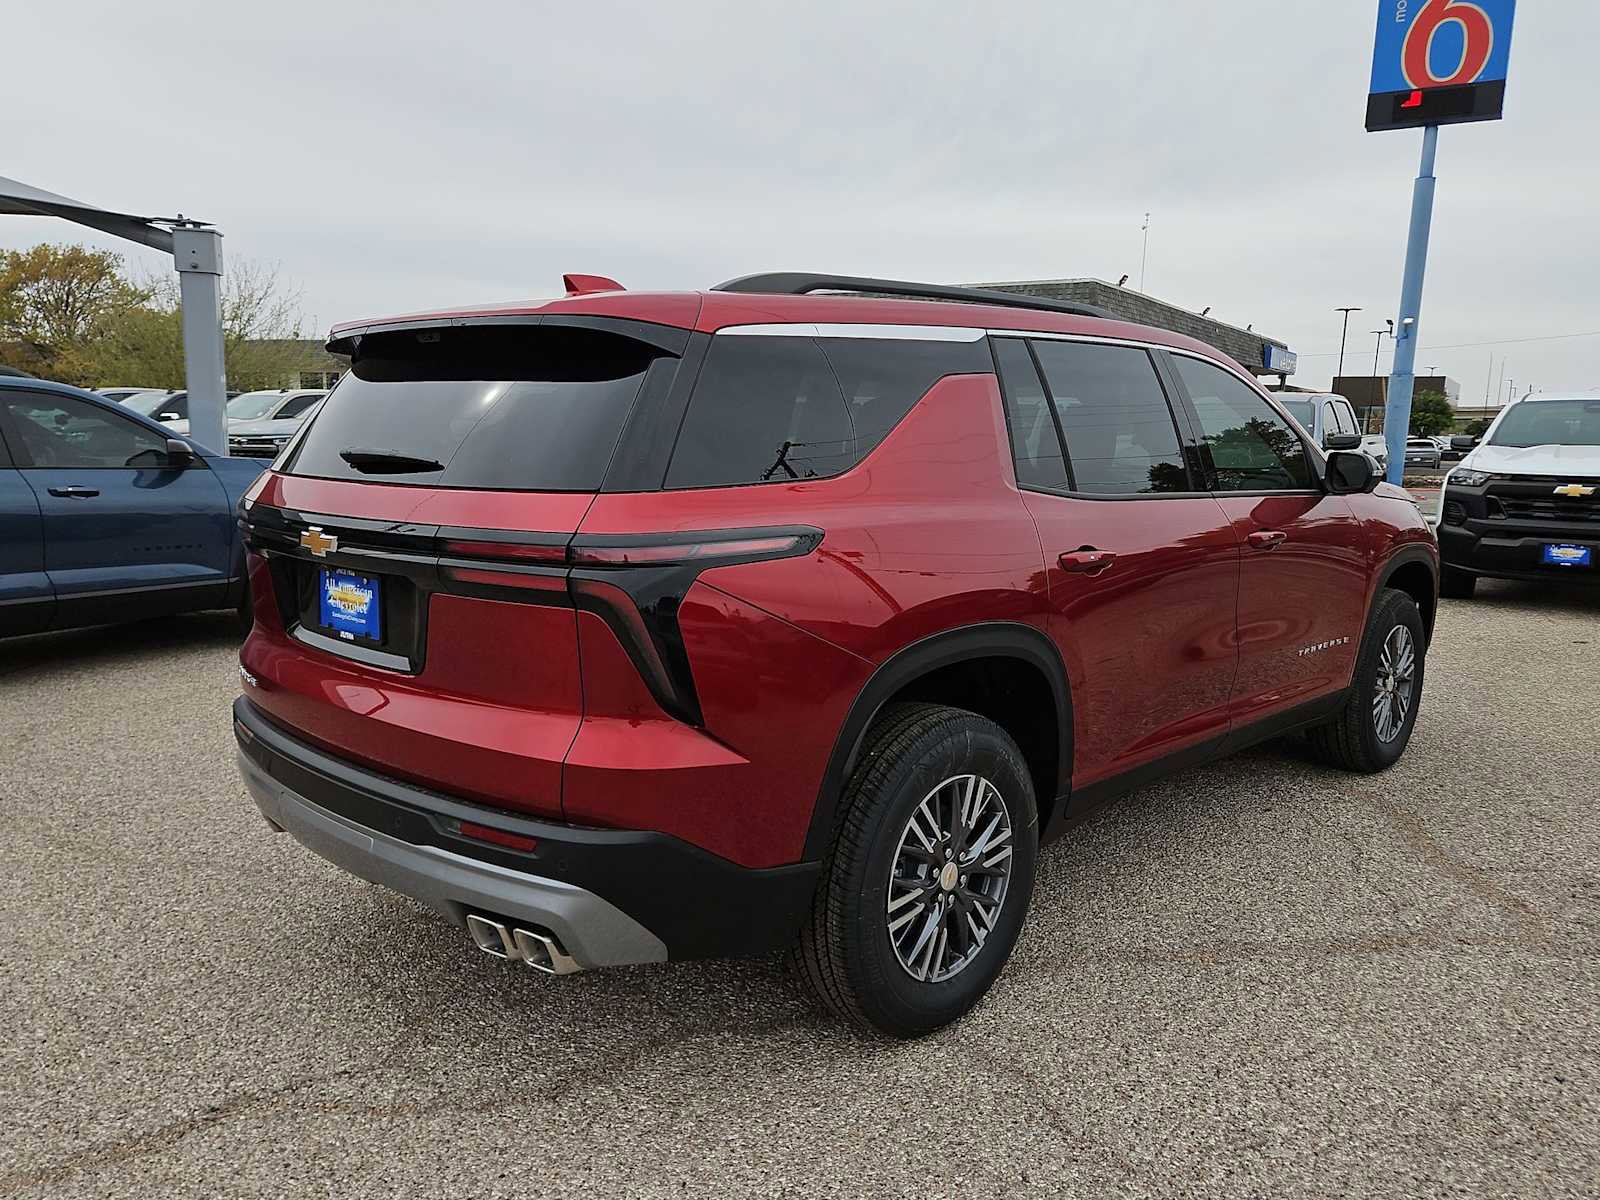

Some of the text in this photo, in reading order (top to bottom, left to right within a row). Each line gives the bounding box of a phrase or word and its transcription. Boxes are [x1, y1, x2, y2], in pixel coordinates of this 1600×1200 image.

[1401, 0, 1494, 89] 6
[324, 578, 336, 591] All
[1297, 636, 1351, 657] TRAVERSE
